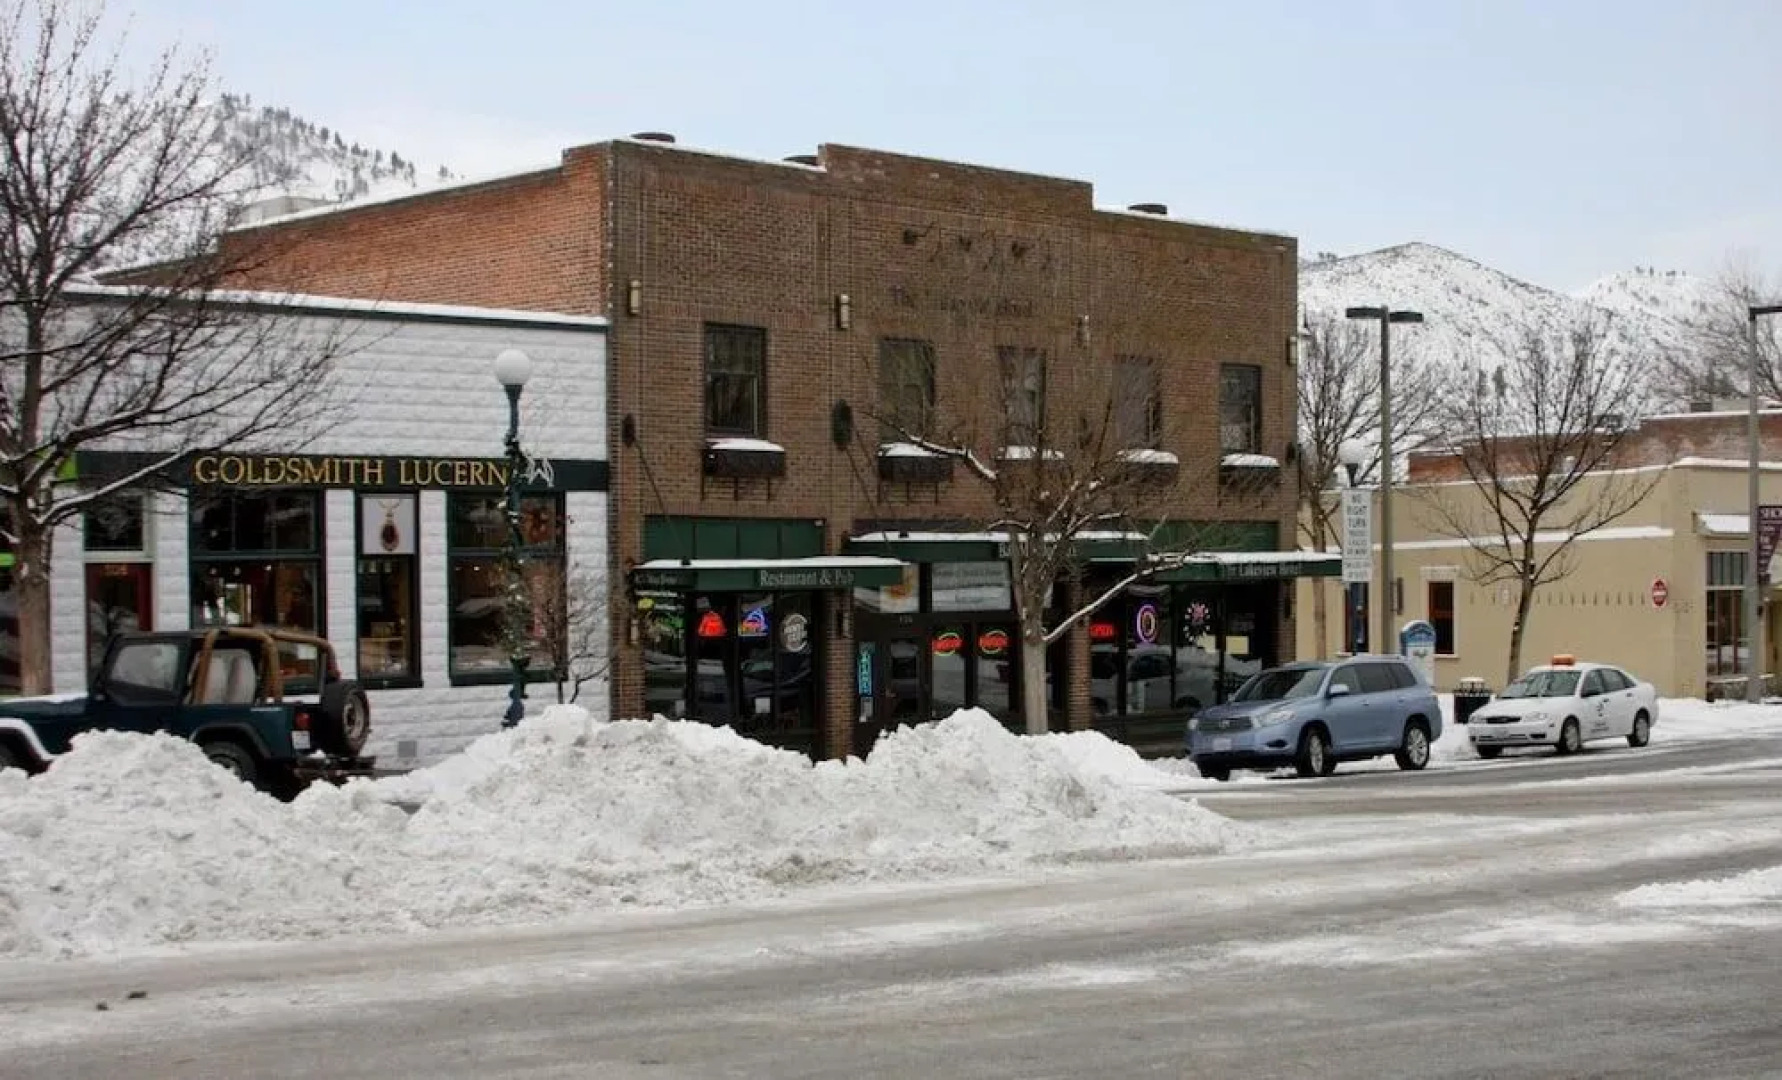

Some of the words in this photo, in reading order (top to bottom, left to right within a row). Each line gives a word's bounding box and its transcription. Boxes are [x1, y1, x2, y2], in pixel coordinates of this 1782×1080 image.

[194, 455, 384, 485] GOLDSMITH
[760, 569, 817, 586] Restaurant
[819, 570, 832, 585] &
